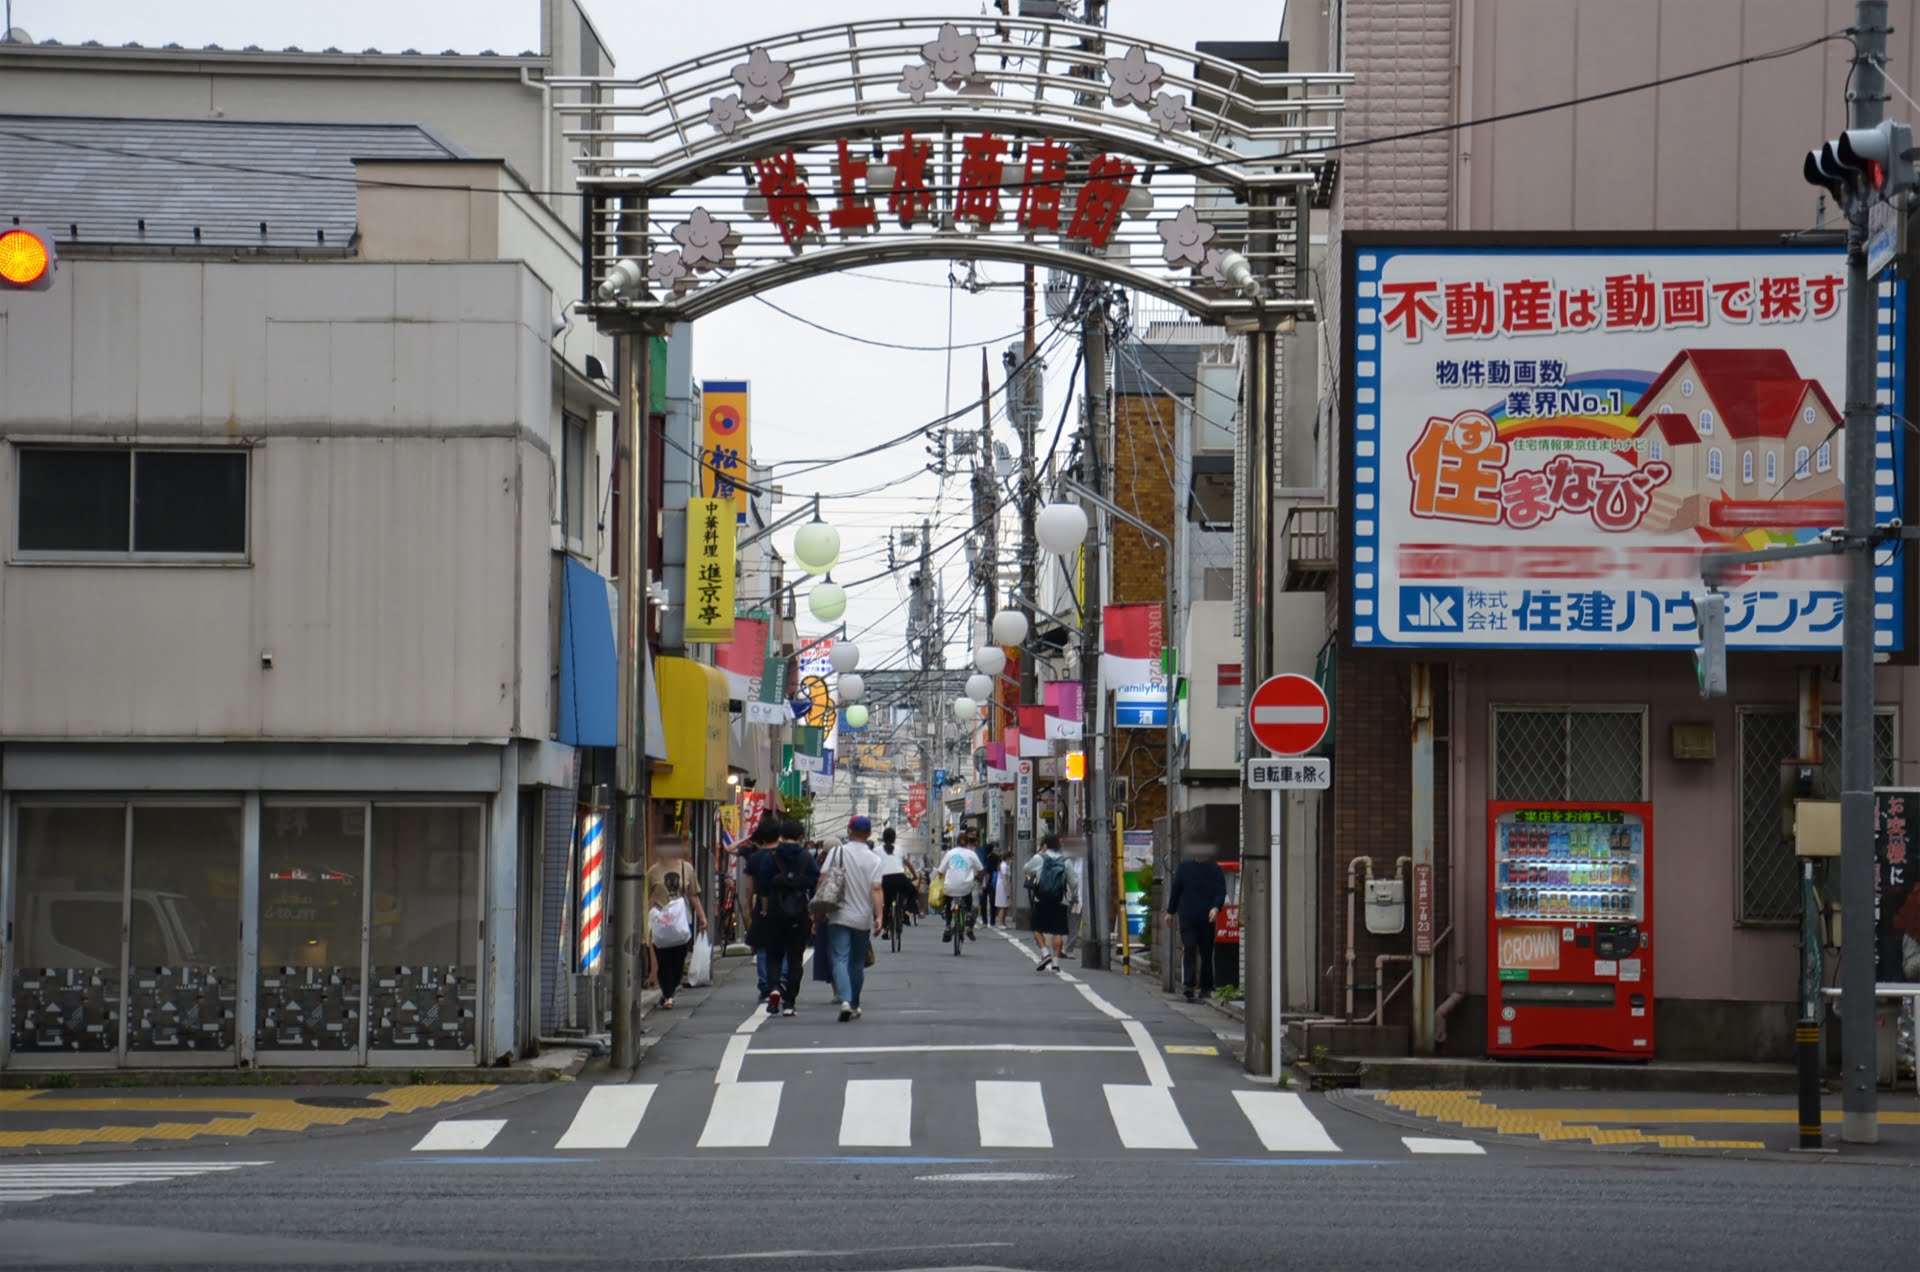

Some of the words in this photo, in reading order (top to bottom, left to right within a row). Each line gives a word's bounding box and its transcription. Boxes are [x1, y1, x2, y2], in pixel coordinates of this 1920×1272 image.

[1380, 273, 1845, 340] 不動産は動画で探す
[1436, 360, 1563, 385] 物件動画数
[1508, 391, 1622, 416] 業界No.1
[1513, 438, 1646, 451] 住宅情報東京住まいナビ
[703, 501, 719, 557] 中華料理
[698, 563, 722, 625] 進京亭
[1406, 592, 1457, 626] JK
[1467, 590, 1508, 608] 株式
[1149, 603, 1163, 648] TOKYO
[1467, 612, 1508, 631] 会社
[1512, 590, 1844, 632] 住建ハウジング
[1149, 652, 1163, 685] 2020
[1139, 710, 1154, 725] 酒
[1253, 765, 1326, 783] 自転車を除く
[1887, 797, 1907, 885] お客様に
[1417, 922, 1430, 931] 23
[1503, 932, 1555, 965] CROWN
